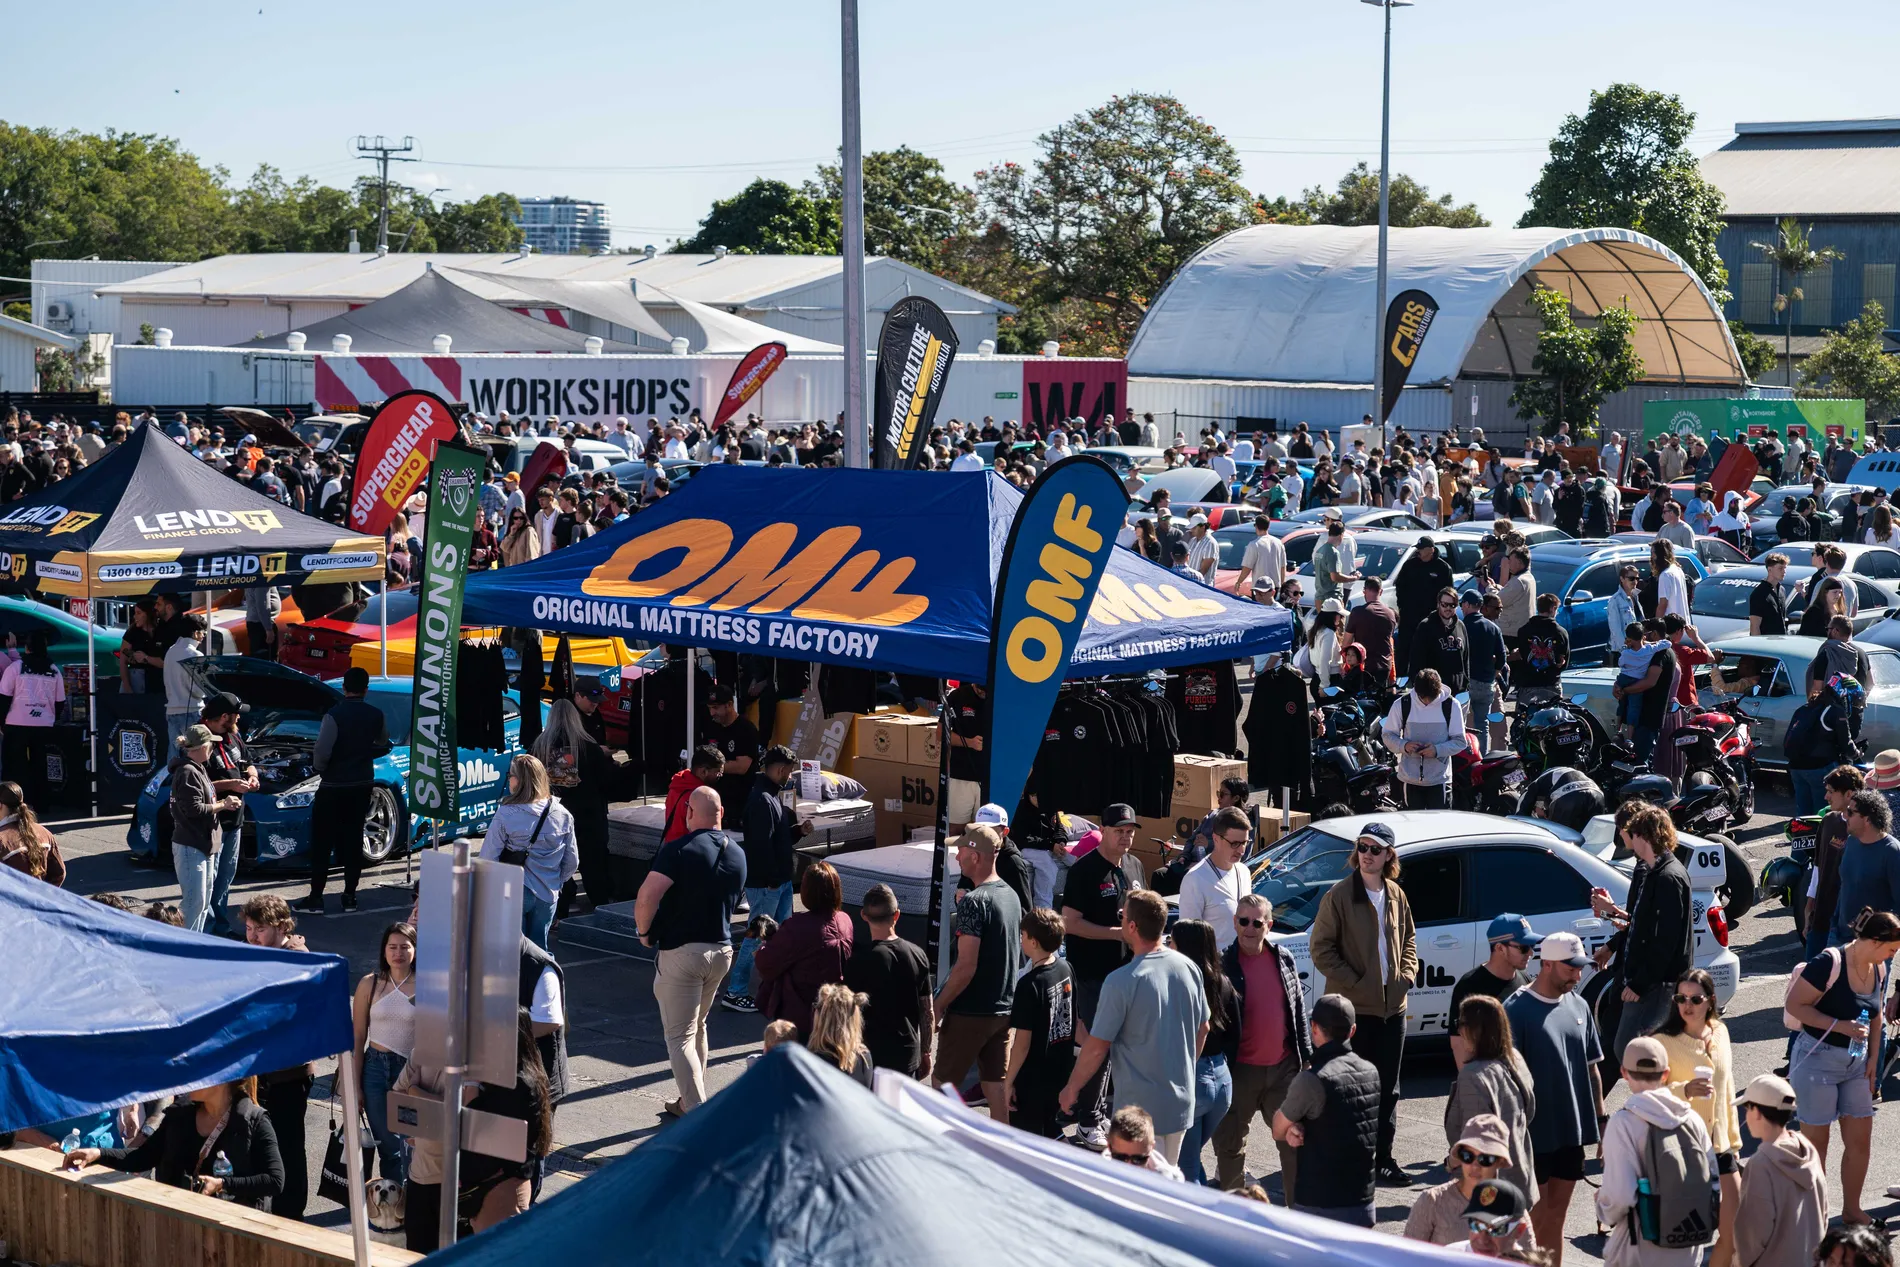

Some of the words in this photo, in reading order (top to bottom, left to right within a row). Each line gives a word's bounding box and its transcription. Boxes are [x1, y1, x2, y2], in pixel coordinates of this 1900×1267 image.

[1391, 300, 1426, 368] CARS
[1416, 307, 1435, 338] CULTURE
[727, 346, 778, 400] SUPERCHEAP
[886, 389, 912, 450] MOTOR
[901, 322, 931, 393] CULTURE
[929, 342, 952, 394] AUSTRALIA
[469, 377, 691, 416] WORKSHOPS
[1668, 410, 1703, 431] CONTAINERS
[352, 401, 434, 526] SUPERCHEAP
[389, 458, 421, 501] AUTO
[143, 528, 198, 541] FINANCE
[199, 527, 242, 537] GROUP
[106, 568, 132, 577] 1300
[135, 567, 155, 577] 082
[158, 565, 176, 575] 012
[306, 554, 374, 567] LENDITFG.COM.AU
[581, 518, 929, 626] OMF
[195, 577, 228, 586] FINANCE
[229, 576, 257, 584] GROUP
[1005, 492, 1103, 684] OMF
[1083, 573, 1228, 629] MF
[532, 594, 635, 629] ORIGINAL
[640, 606, 761, 645] MATTRESS
[768, 622, 879, 660] FACTORY
[1070, 645, 1117, 663] IGINAL
[1119, 636, 1187, 658] MATTRESS
[1190, 630, 1245, 649] FACTORY
[415, 542, 458, 809] SHANNONS
[1185, 695, 1217, 704] FURIOUS
[815, 720, 846, 768] bib
[439, 740, 456, 811] INSURANCE
[902, 775, 935, 806] bib
[1697, 851, 1721, 868] 06
[205, 1135, 217, 1149] AJE
[323, 1167, 349, 1187] METHO
[1666, 1231, 1709, 1244] adidas
